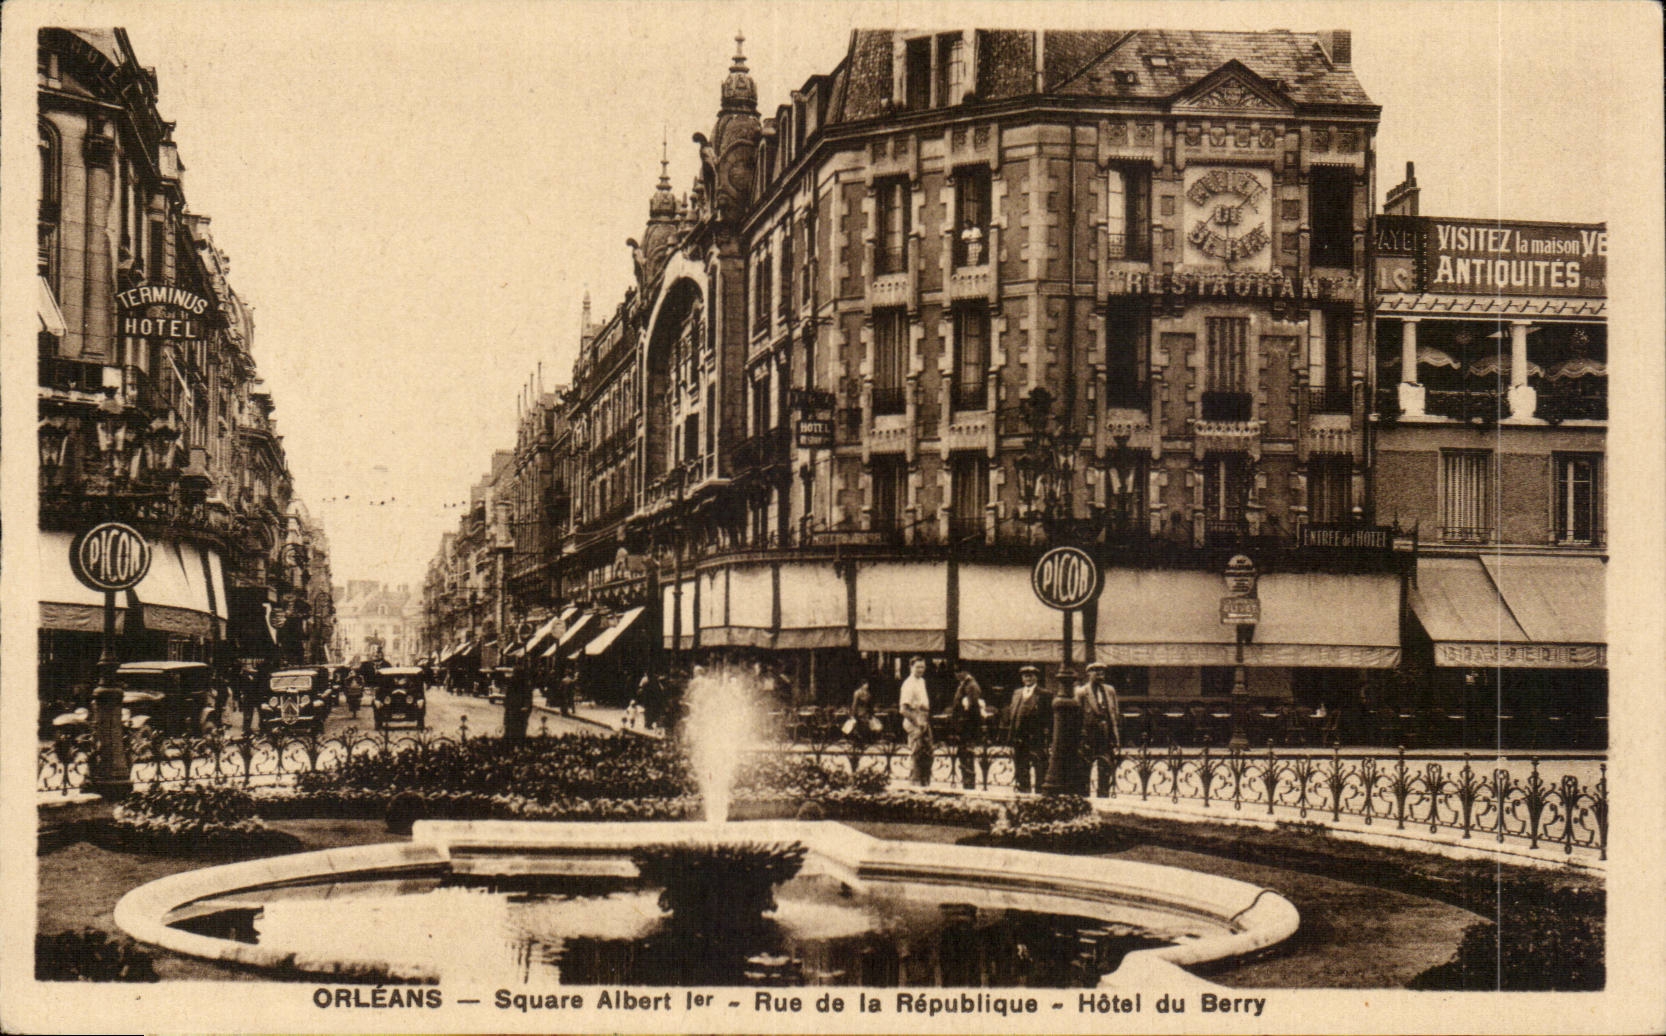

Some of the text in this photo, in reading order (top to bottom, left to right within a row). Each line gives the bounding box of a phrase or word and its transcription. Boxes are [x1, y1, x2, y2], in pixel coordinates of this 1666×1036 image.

[1437, 225, 1512, 253] VISITEZ
[1516, 231, 1528, 253] la
[1531, 238, 1580, 254] maison
[1434, 255, 1580, 288] ANTIQUITÉS
[117, 286, 208, 314] TERMINUS
[125, 318, 196, 338] HOTEL
[801, 422, 830, 433] HOTEL
[89, 529, 140, 582] PICON
[1043, 553, 1088, 602] PICON
